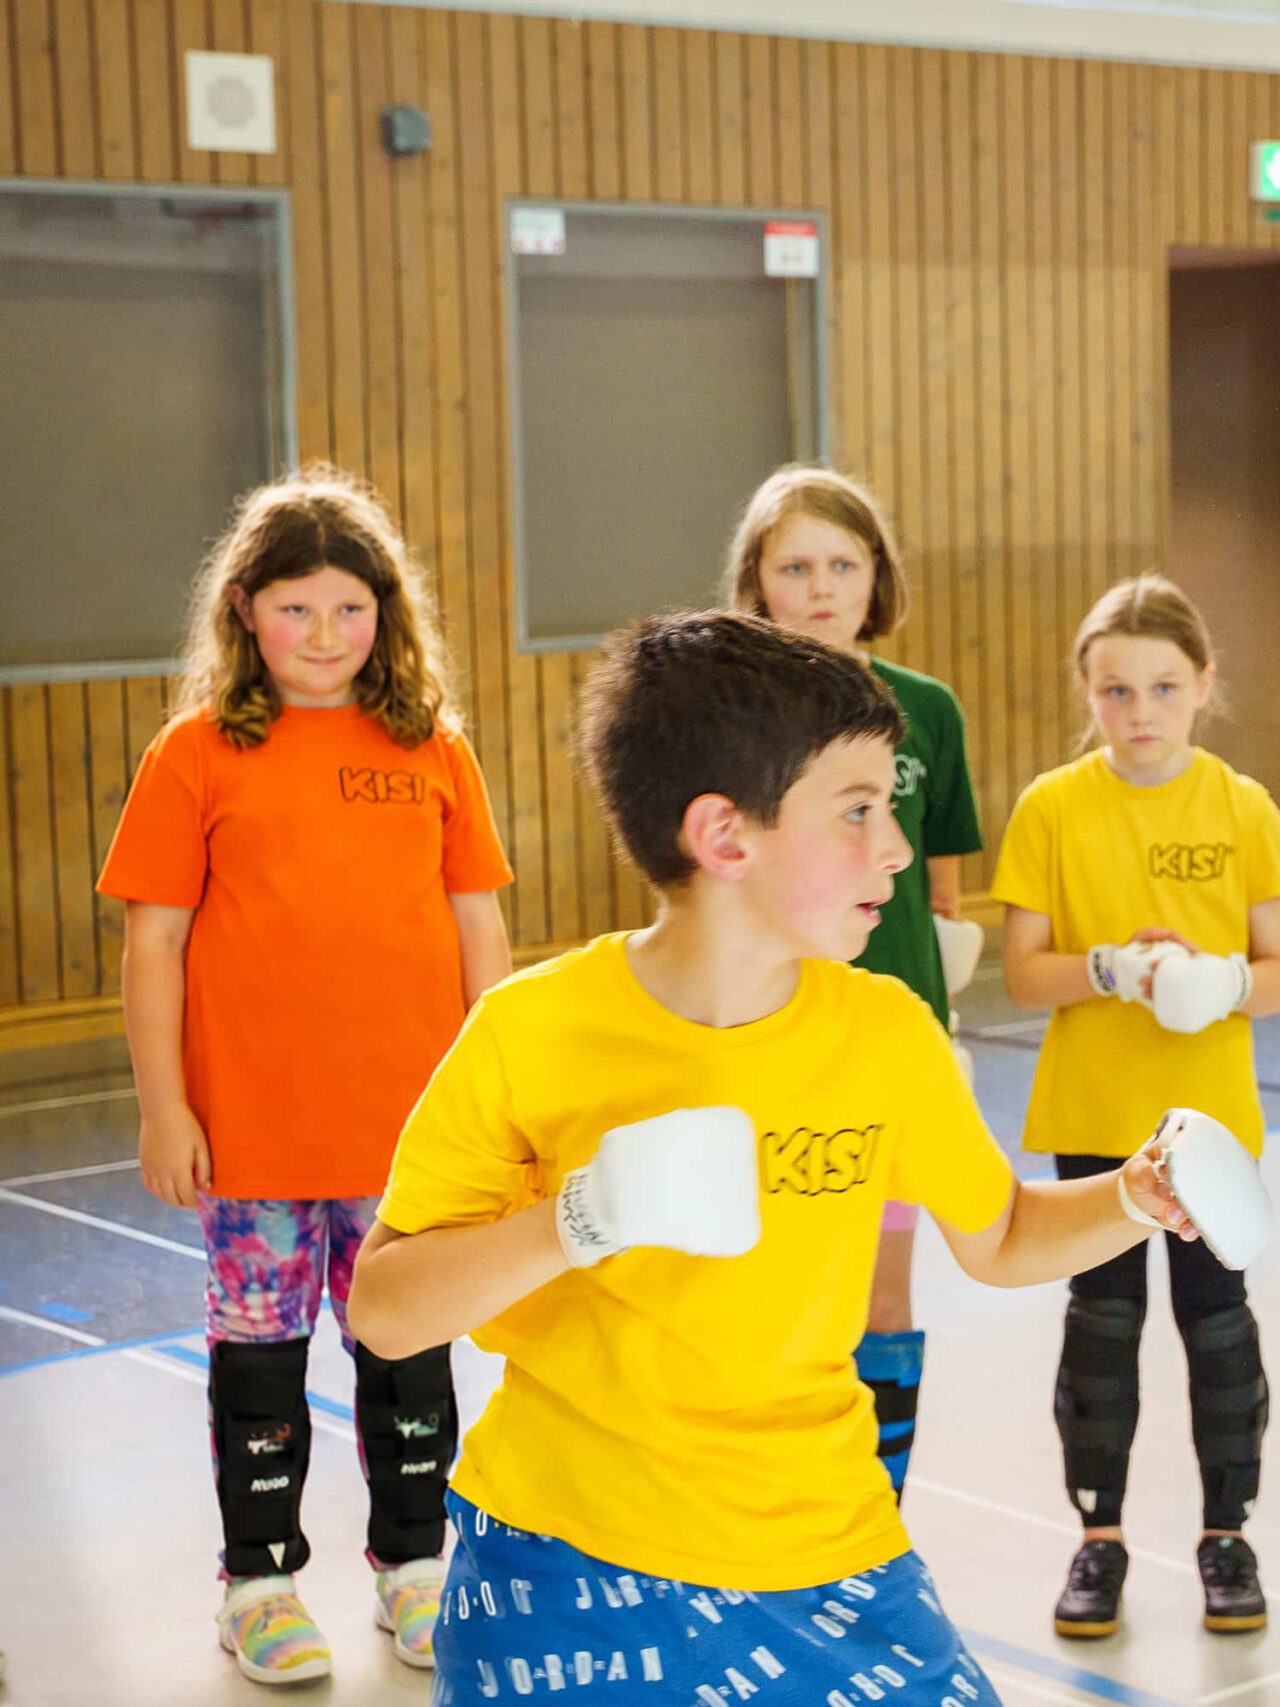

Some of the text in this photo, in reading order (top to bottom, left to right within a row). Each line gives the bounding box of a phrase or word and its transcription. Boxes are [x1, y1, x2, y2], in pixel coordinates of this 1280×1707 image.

[338, 766, 425, 805] KISI
[894, 754, 927, 797] SI
[1148, 841, 1234, 882] KISI
[759, 1124, 883, 1197] KISI
